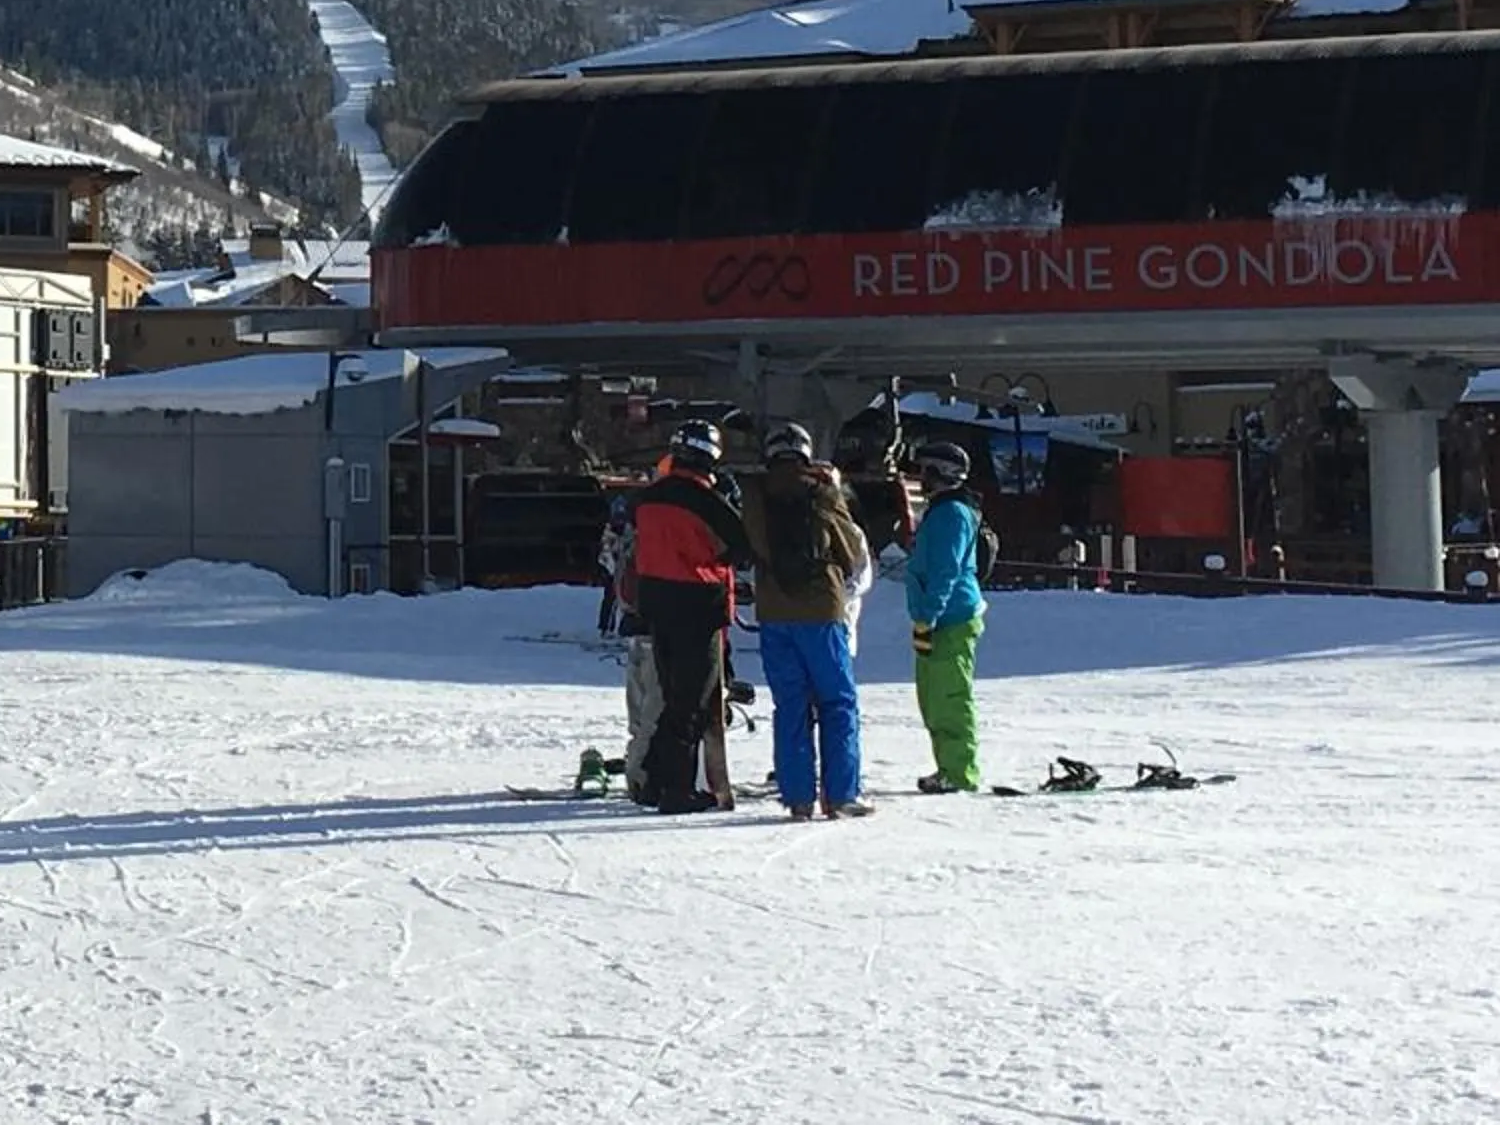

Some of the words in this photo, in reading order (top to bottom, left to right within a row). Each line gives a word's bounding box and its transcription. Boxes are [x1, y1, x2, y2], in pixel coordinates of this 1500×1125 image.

[853, 254, 960, 296] RED
[984, 247, 1113, 292] PINE
[1138, 239, 1460, 288] GONDOLA
